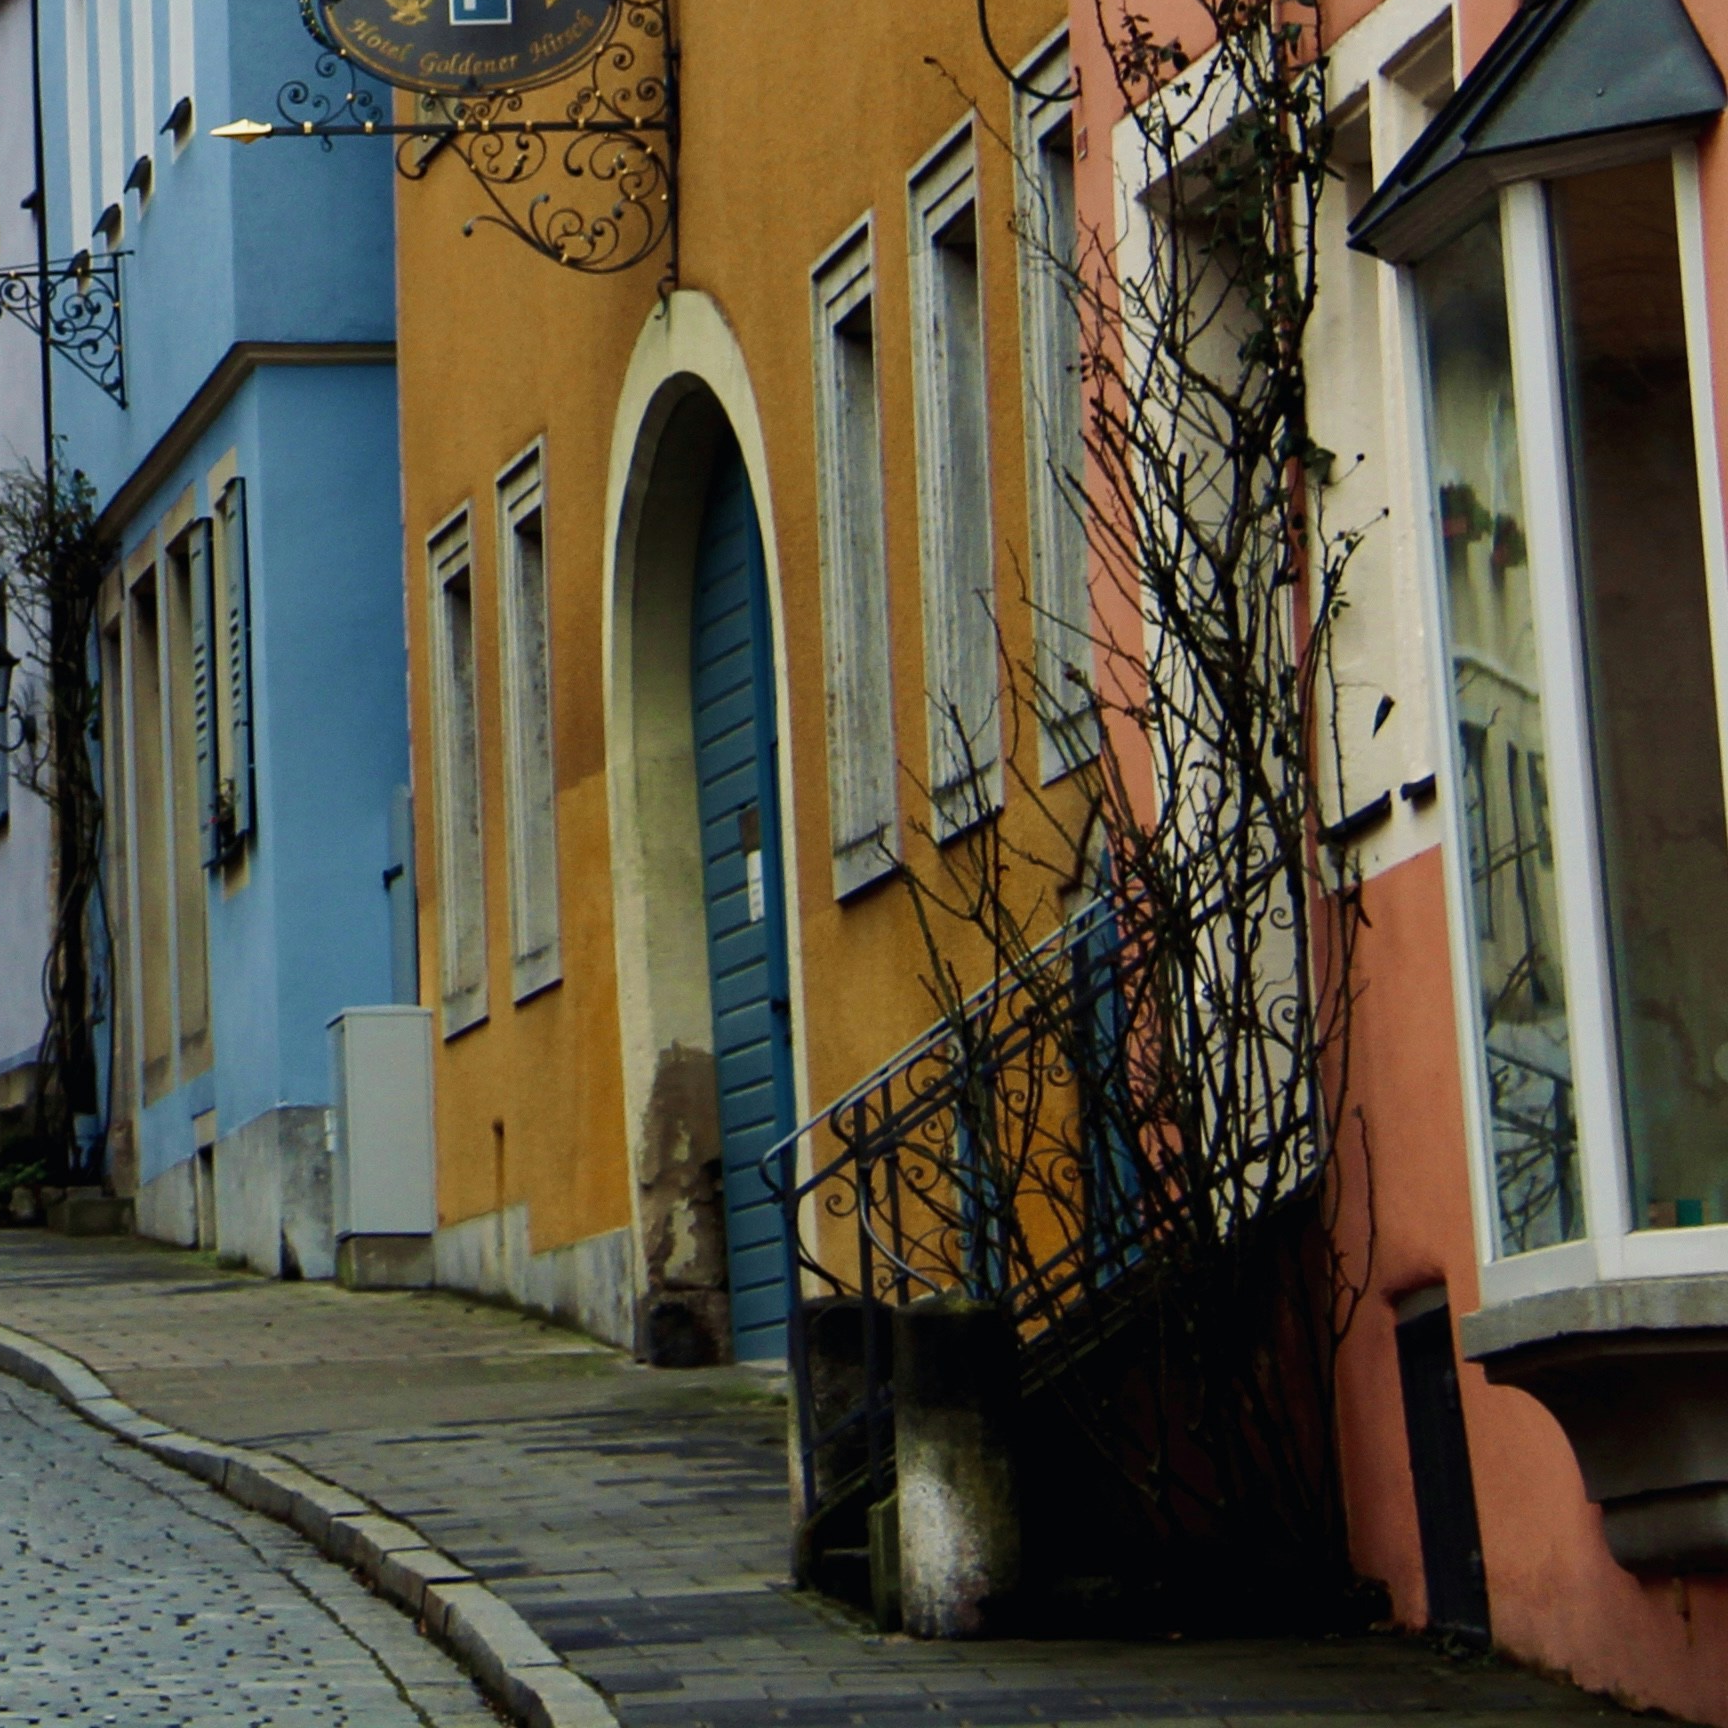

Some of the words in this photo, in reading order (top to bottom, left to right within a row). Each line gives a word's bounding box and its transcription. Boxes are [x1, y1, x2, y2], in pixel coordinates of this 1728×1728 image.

[346, 18, 415, 63] Hotel
[419, 51, 519, 76] Goldener
[528, 8, 594, 63] Hirsch
